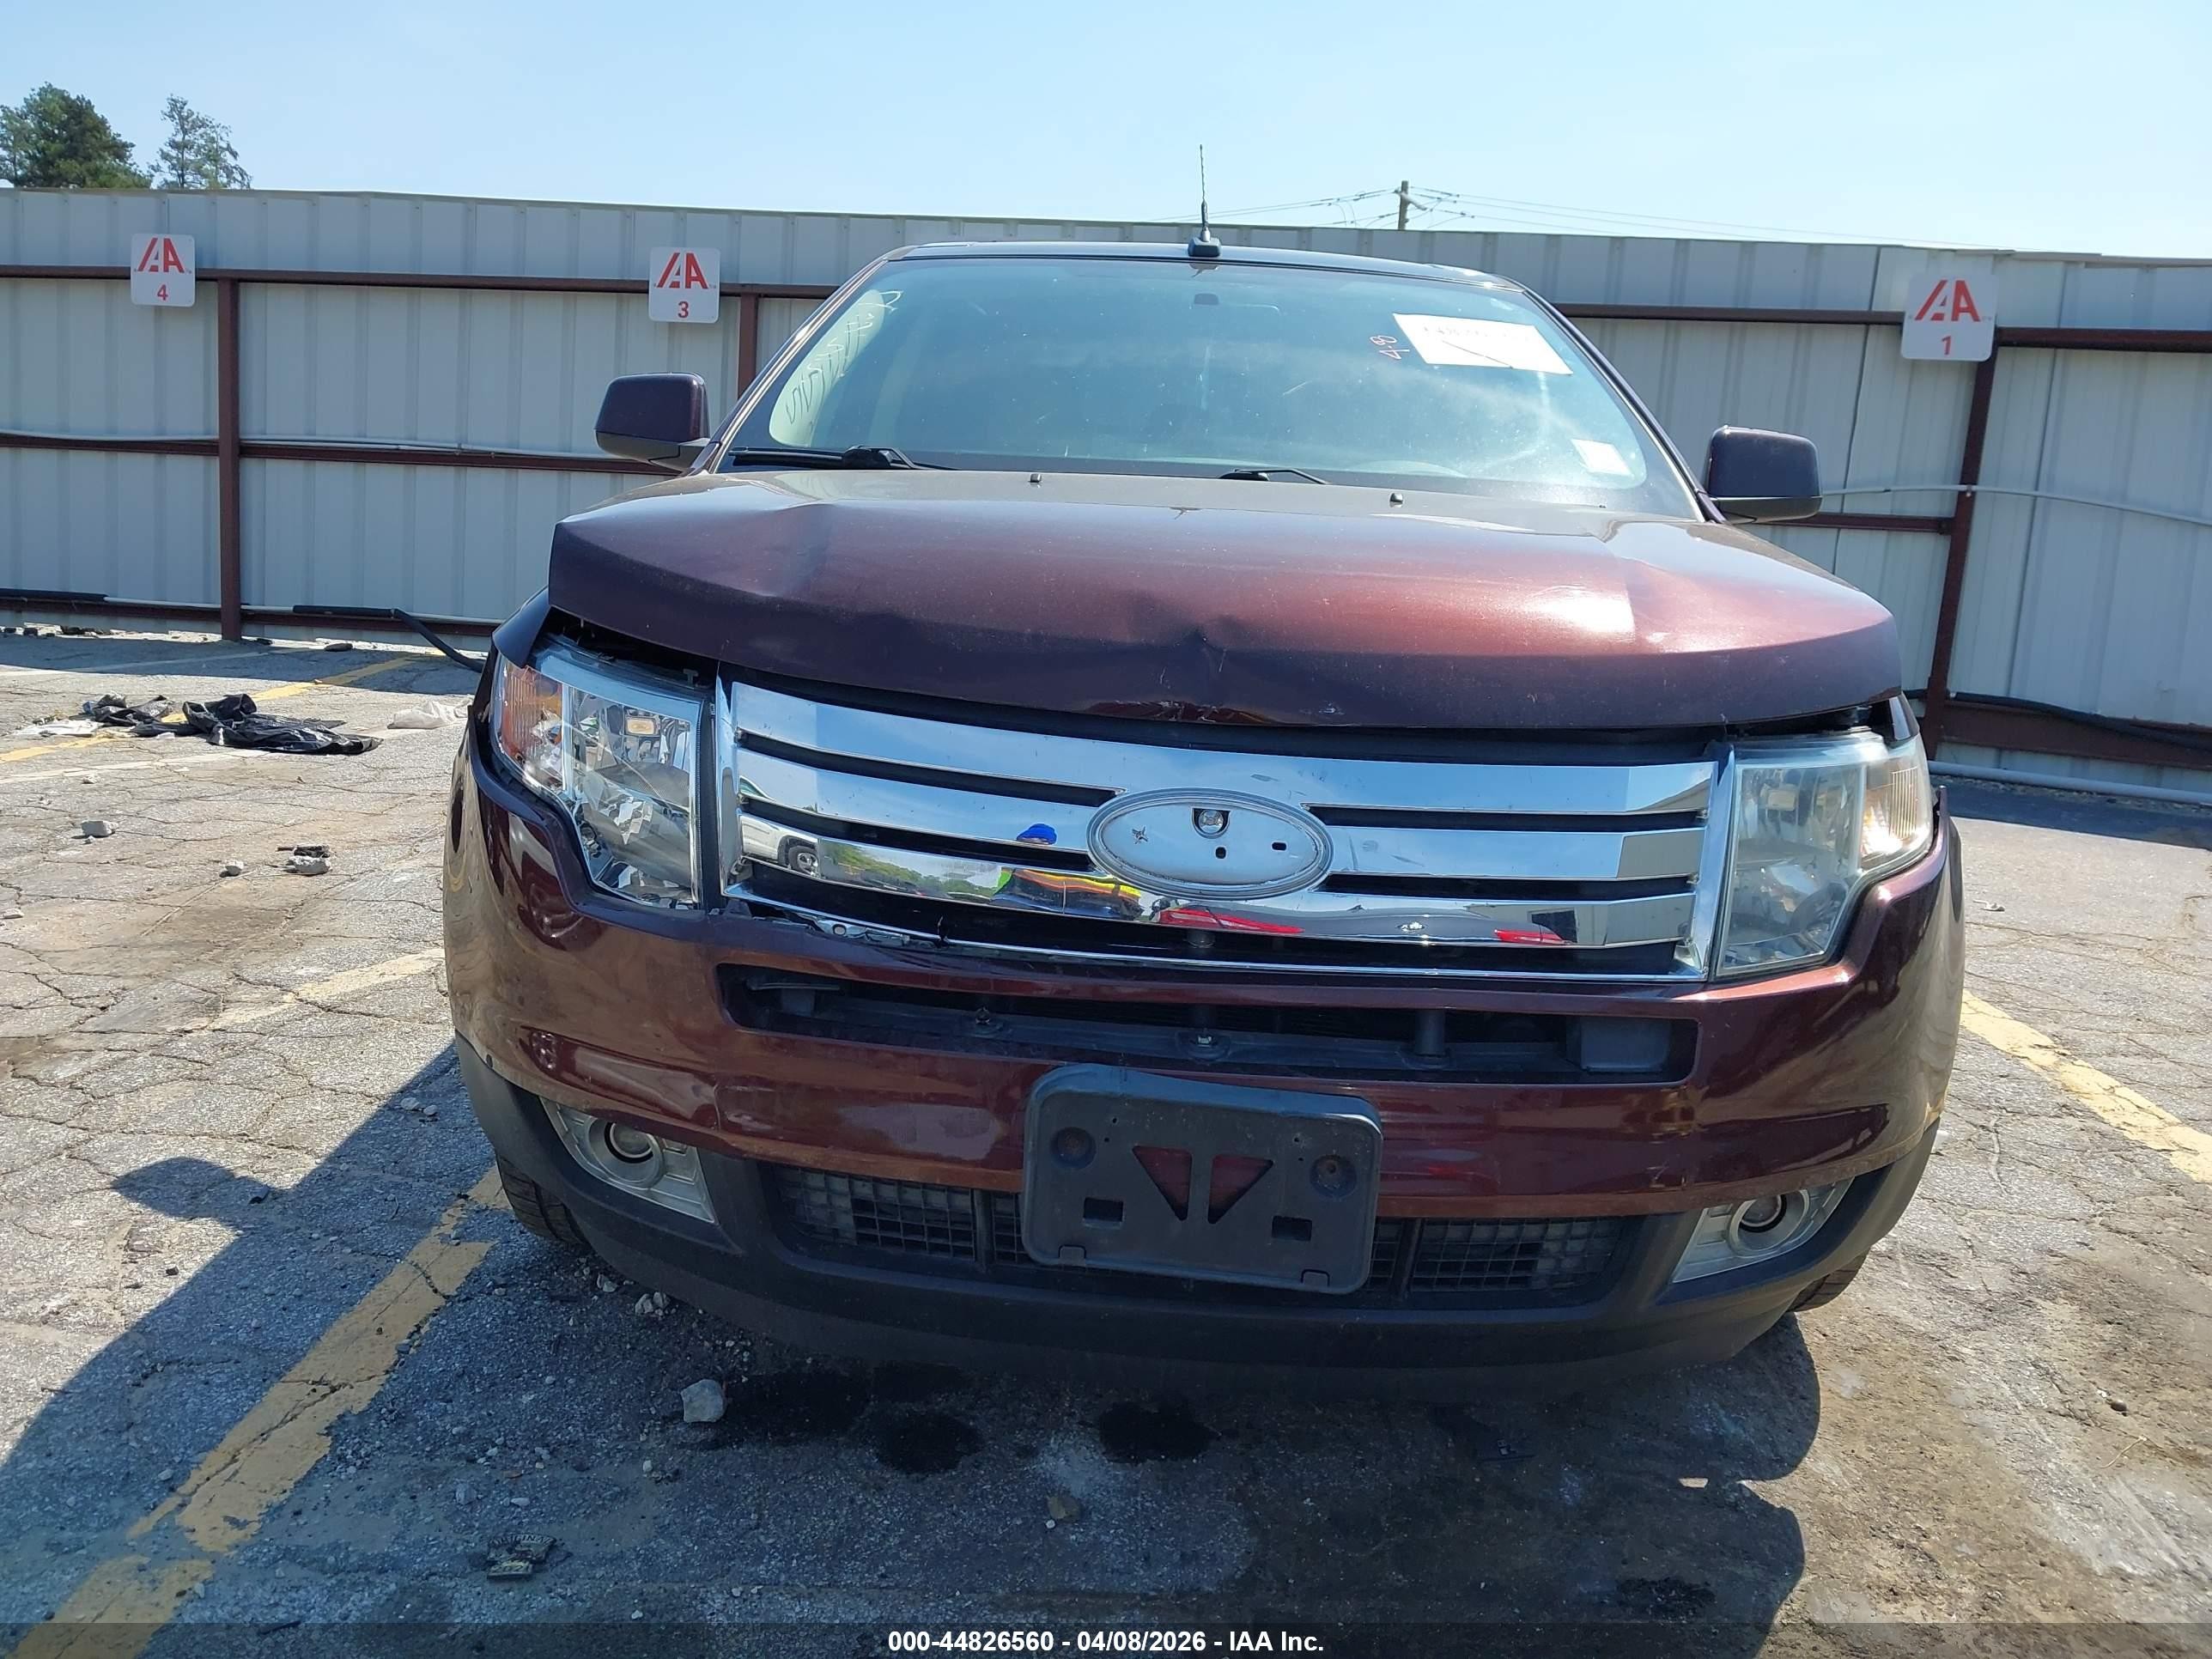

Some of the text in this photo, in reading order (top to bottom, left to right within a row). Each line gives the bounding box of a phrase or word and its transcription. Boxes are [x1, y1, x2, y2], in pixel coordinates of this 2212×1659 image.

[157, 284, 168, 301] 4
[678, 301, 690, 319] 3
[1942, 335, 1952, 356] 1
